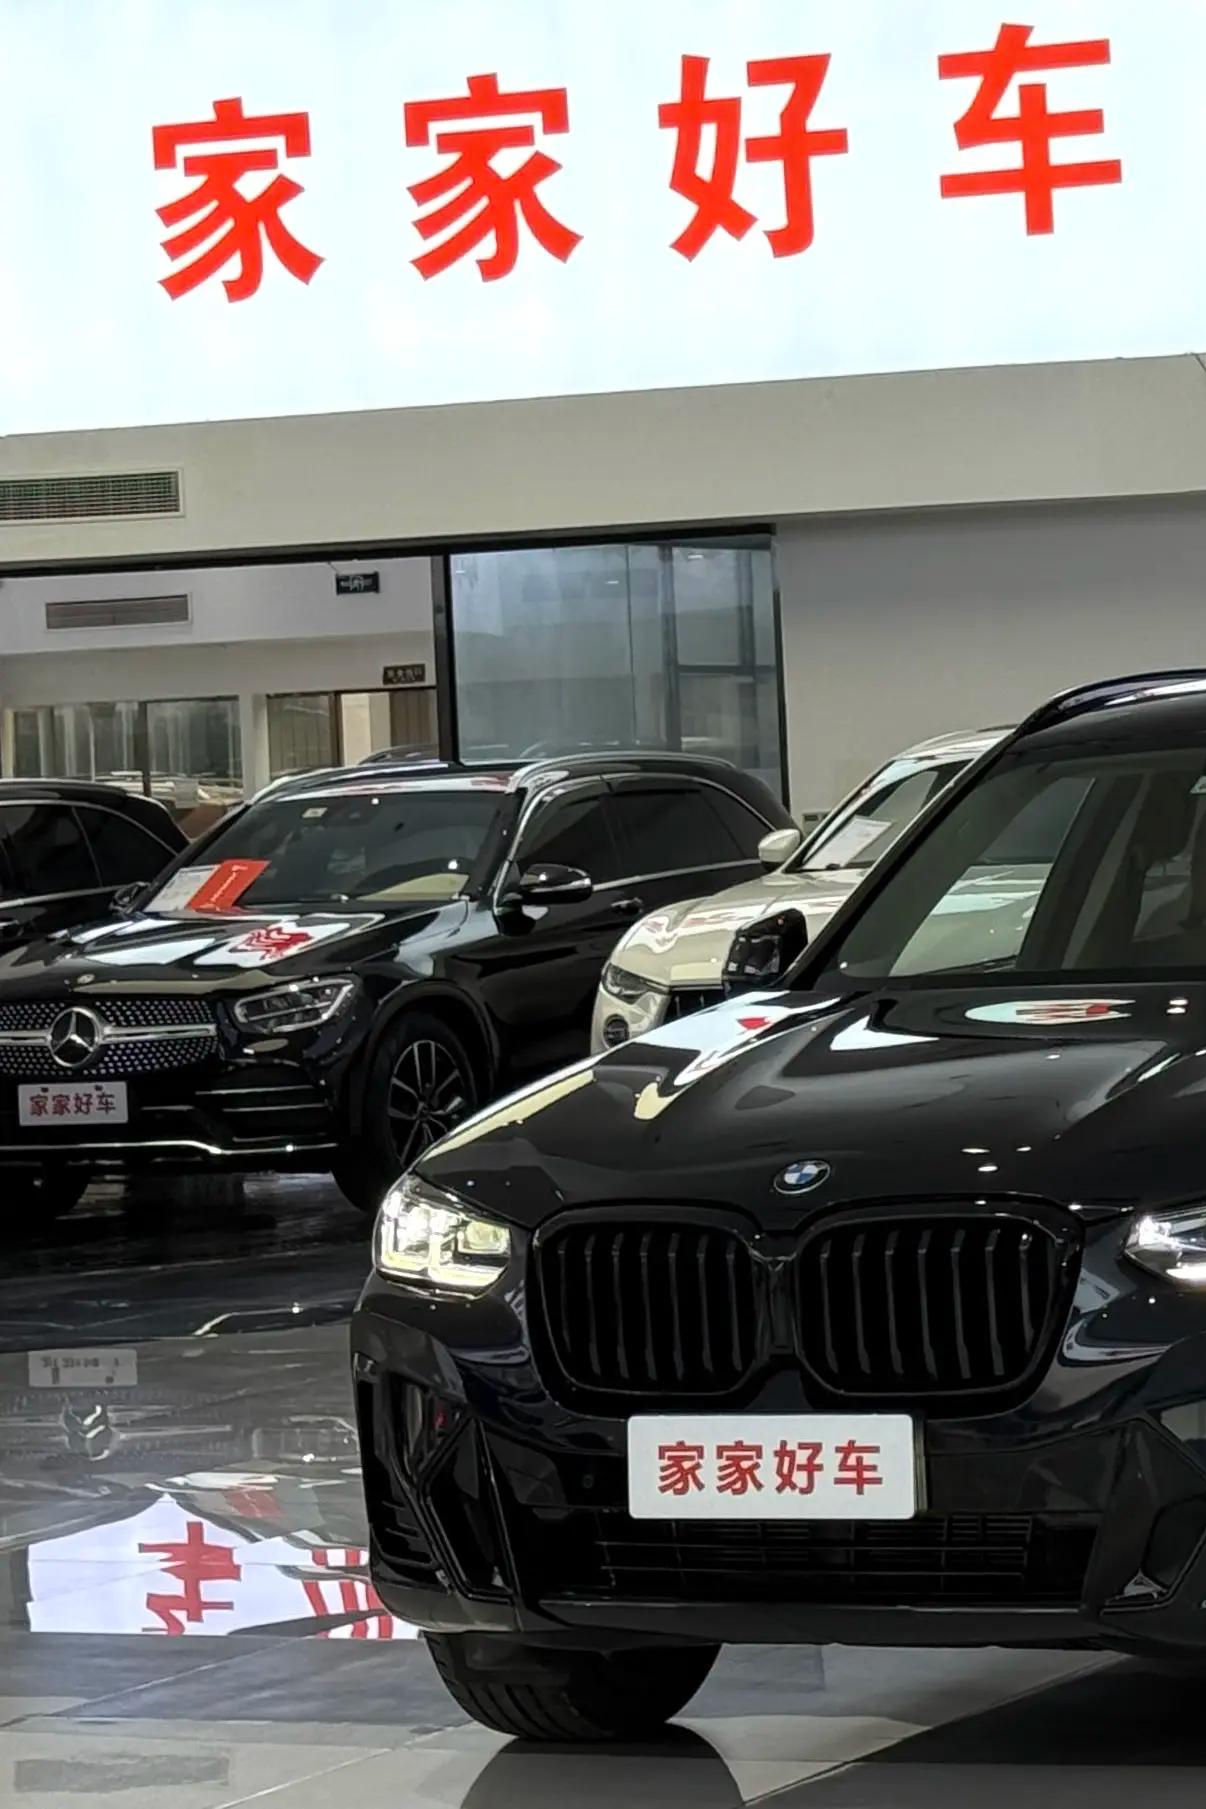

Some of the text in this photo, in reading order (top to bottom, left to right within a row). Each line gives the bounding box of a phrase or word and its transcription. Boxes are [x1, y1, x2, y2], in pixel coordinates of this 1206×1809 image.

[151, 23, 1123, 303] 家家好车
[30, 1092, 116, 1117] 家家好车
[657, 1440, 883, 1496] 家家好车
